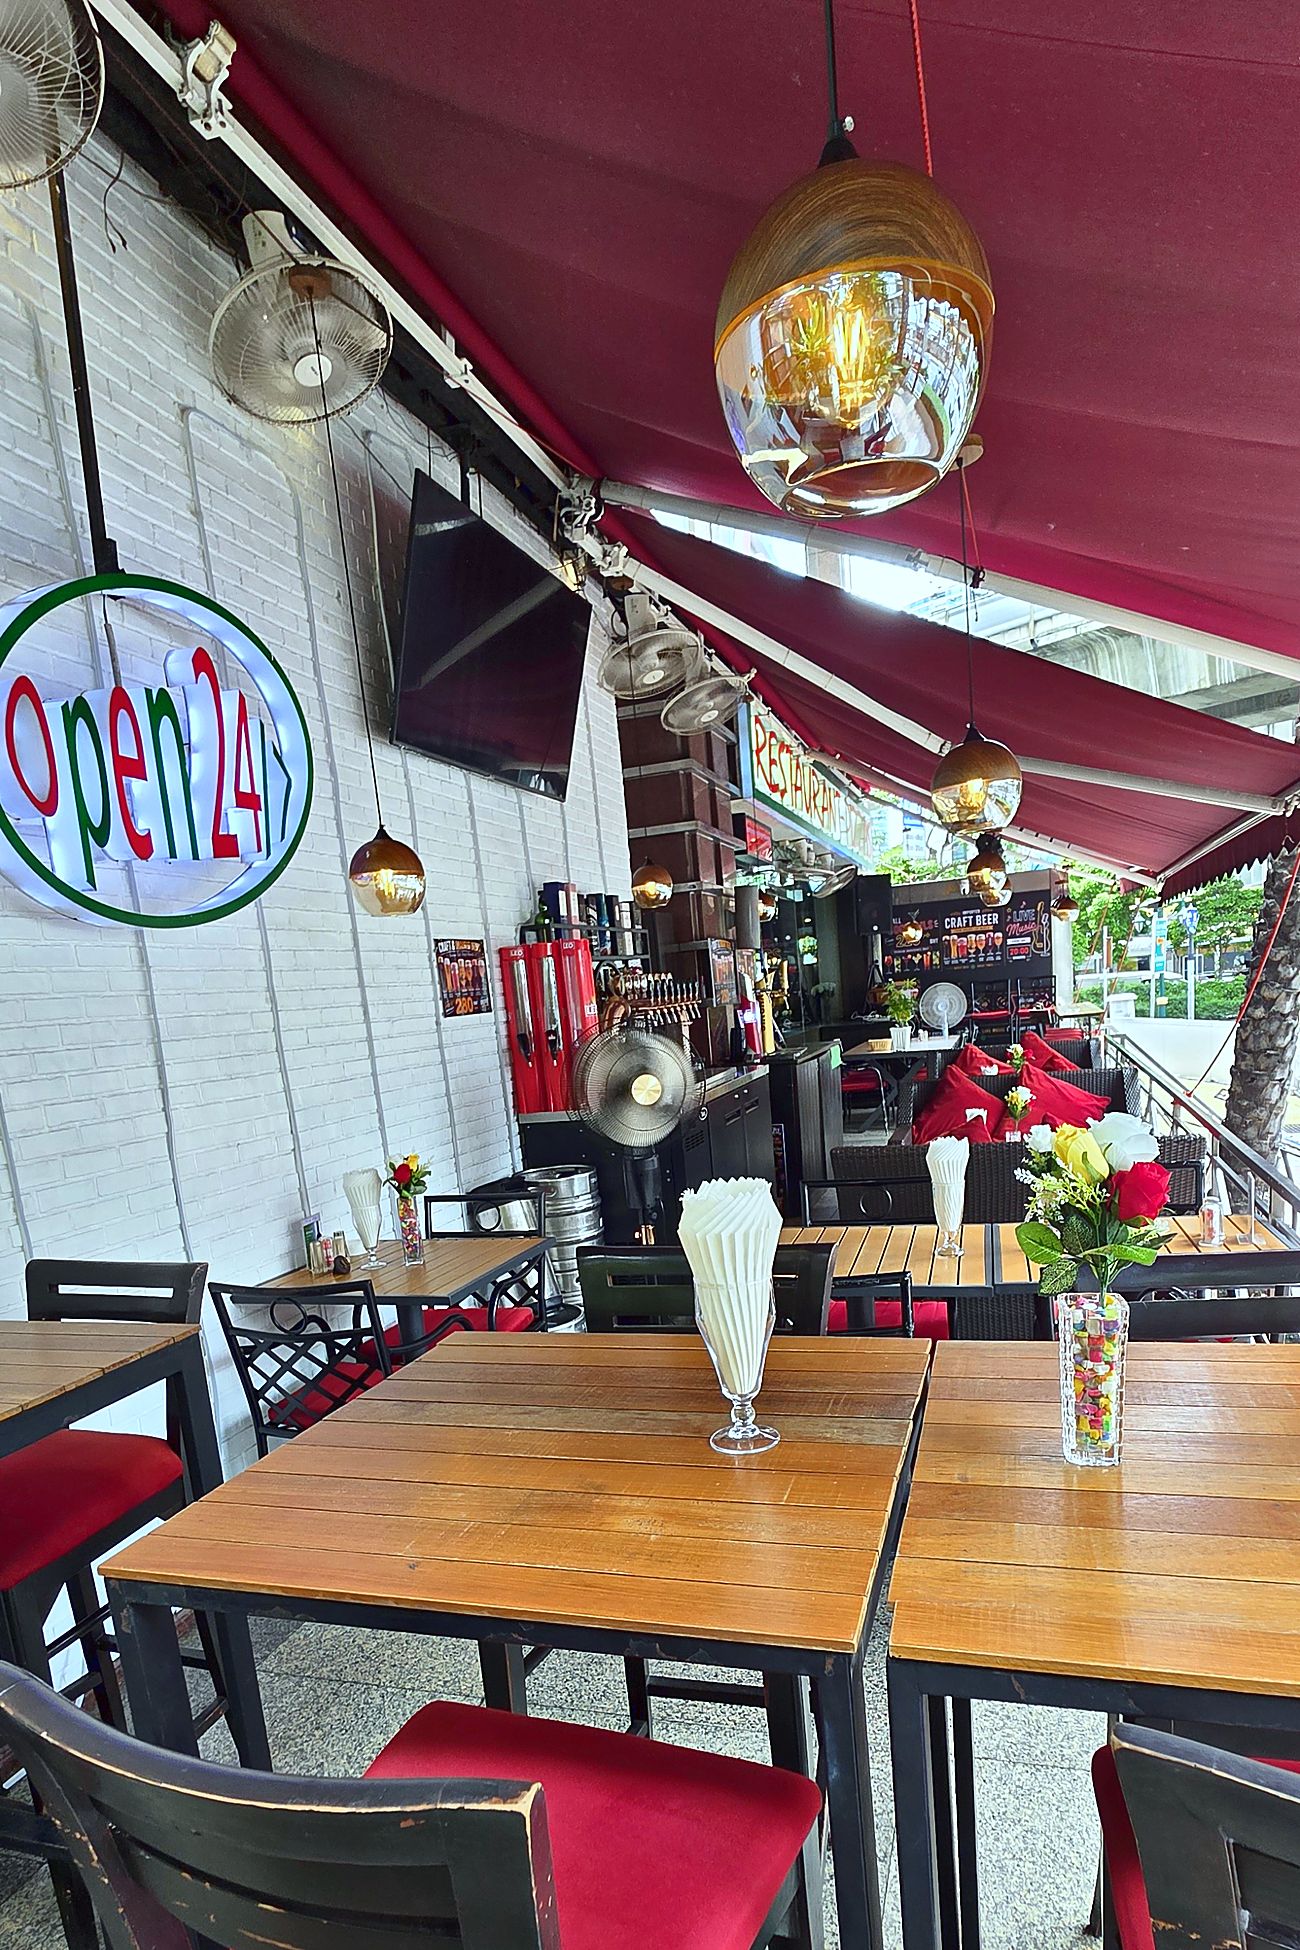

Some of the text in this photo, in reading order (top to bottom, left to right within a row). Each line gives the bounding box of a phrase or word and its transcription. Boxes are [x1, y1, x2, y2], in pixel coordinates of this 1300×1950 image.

[944, 916, 973, 930] CRAFT
[975, 913, 999, 926] BEER
[1012, 909, 1036, 922] LIVE
[1006, 922, 1038, 936] Music
